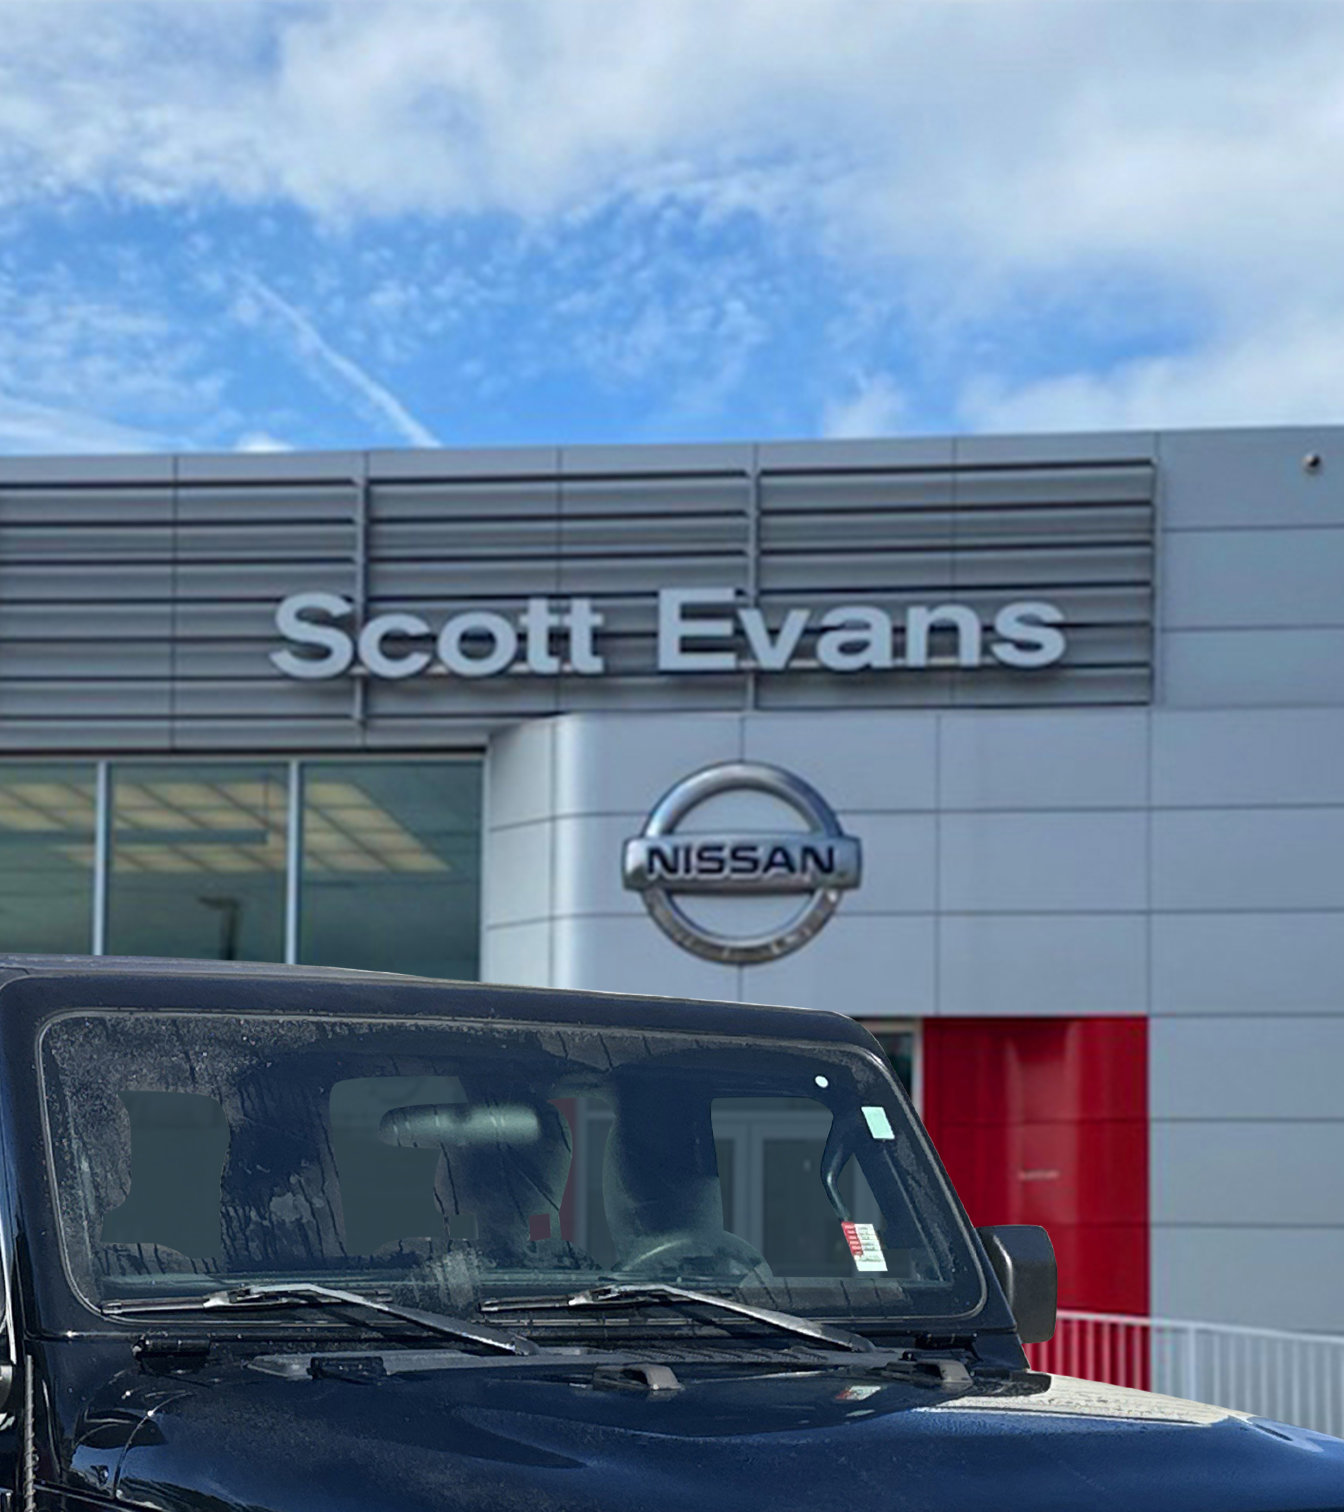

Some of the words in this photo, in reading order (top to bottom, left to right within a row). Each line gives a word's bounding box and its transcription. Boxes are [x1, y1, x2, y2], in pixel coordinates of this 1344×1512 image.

[269, 591, 605, 680] Scott
[658, 588, 1067, 672] Evans
[646, 845, 838, 880] NISSAN
